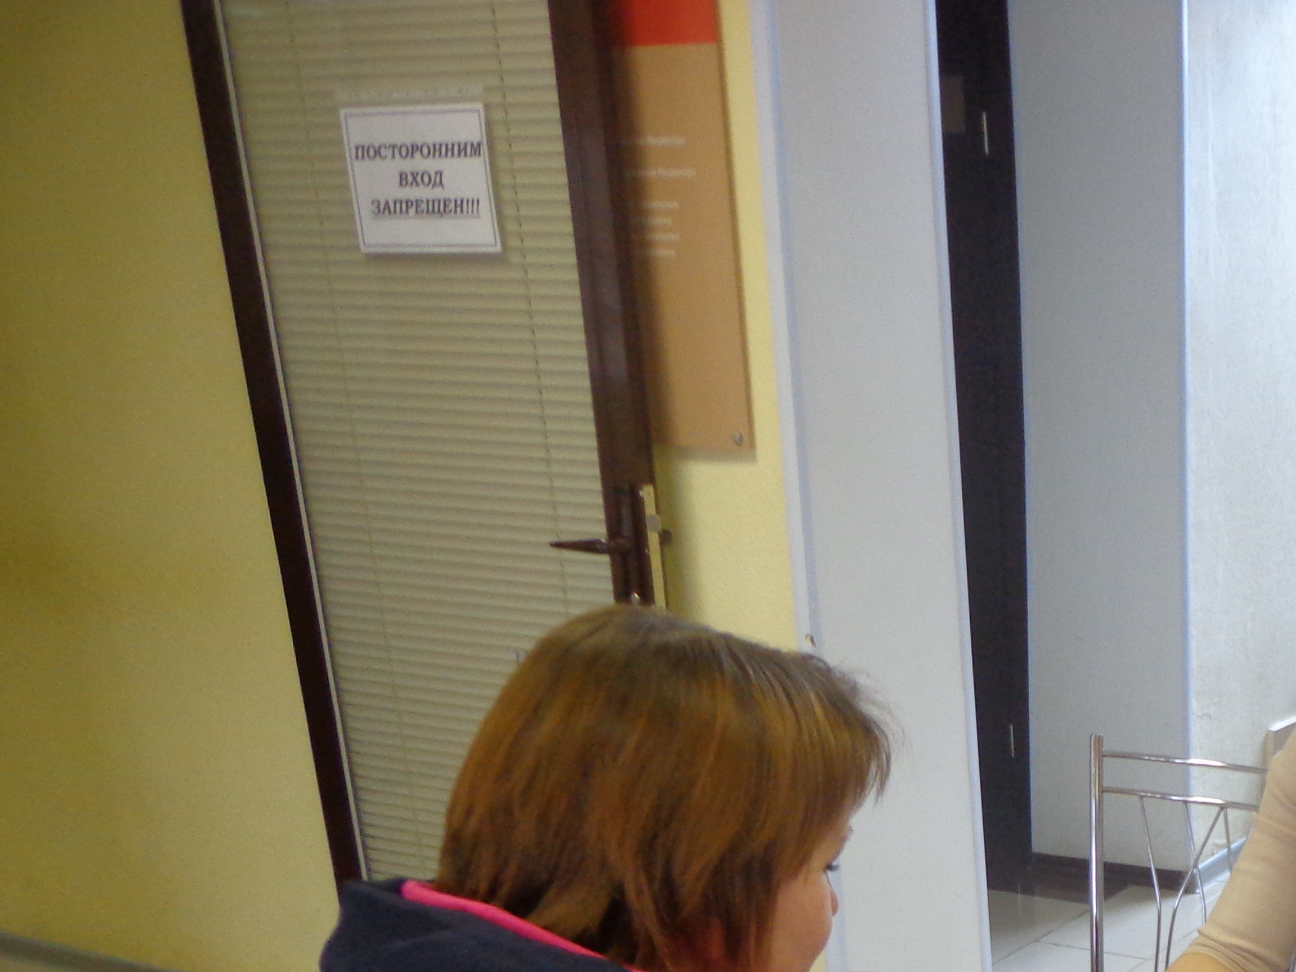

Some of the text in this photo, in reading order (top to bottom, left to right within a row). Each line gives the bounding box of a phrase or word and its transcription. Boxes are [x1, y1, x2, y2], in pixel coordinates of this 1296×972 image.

[355, 141, 482, 160] ПОСТОРОННИМ
[398, 170, 445, 189] ВХОД
[371, 197, 481, 217] ЗАПРЕЩЕН!!!
